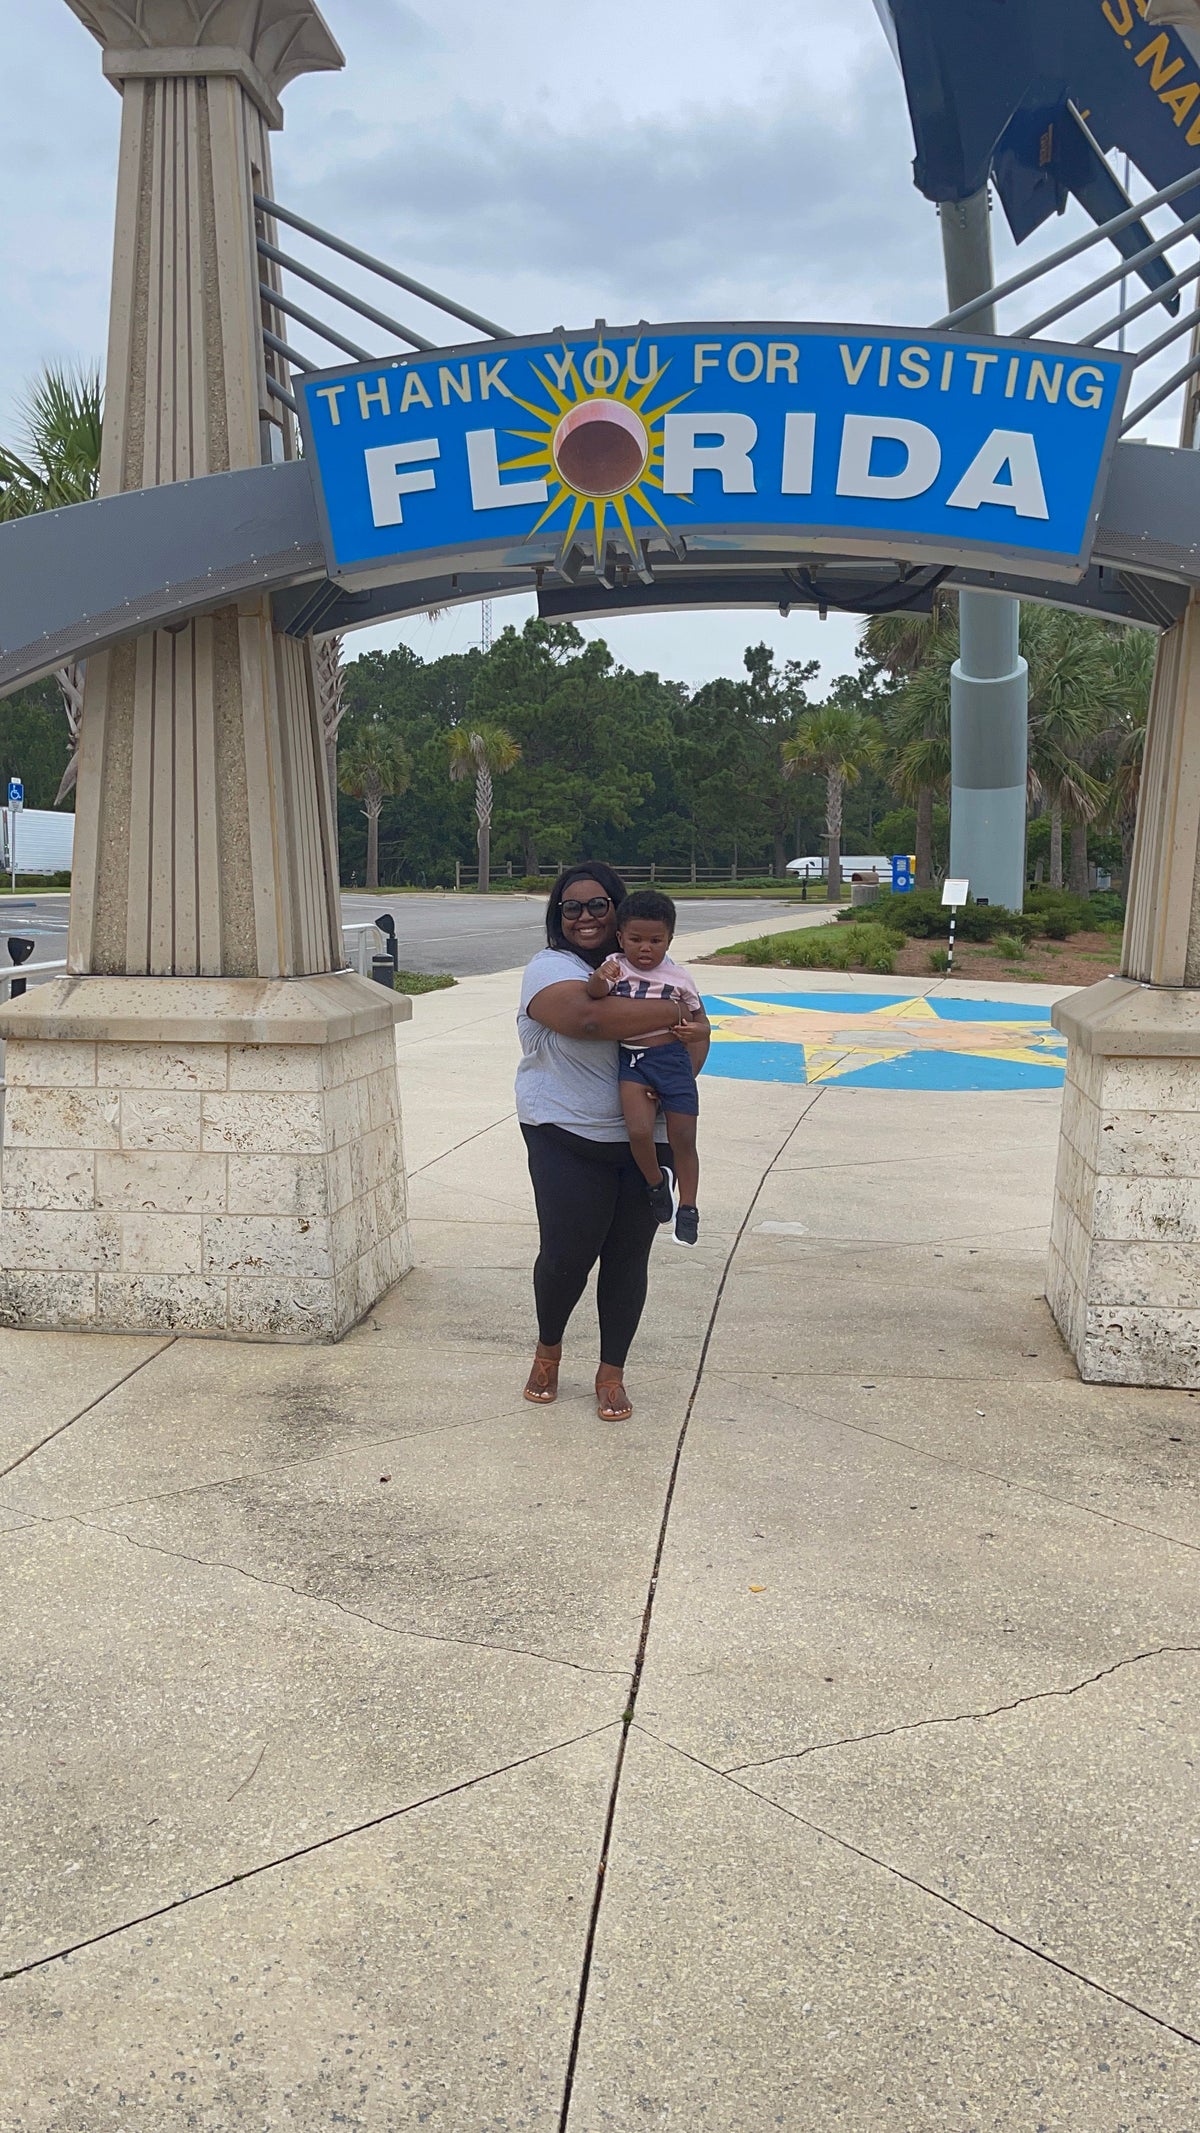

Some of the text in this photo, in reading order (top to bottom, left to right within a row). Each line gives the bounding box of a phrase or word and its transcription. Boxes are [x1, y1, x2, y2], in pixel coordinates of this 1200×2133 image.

[316, 342, 1105, 426] THANK YOU FOR VISITING
[364, 399, 1049, 528] FLORIDA
